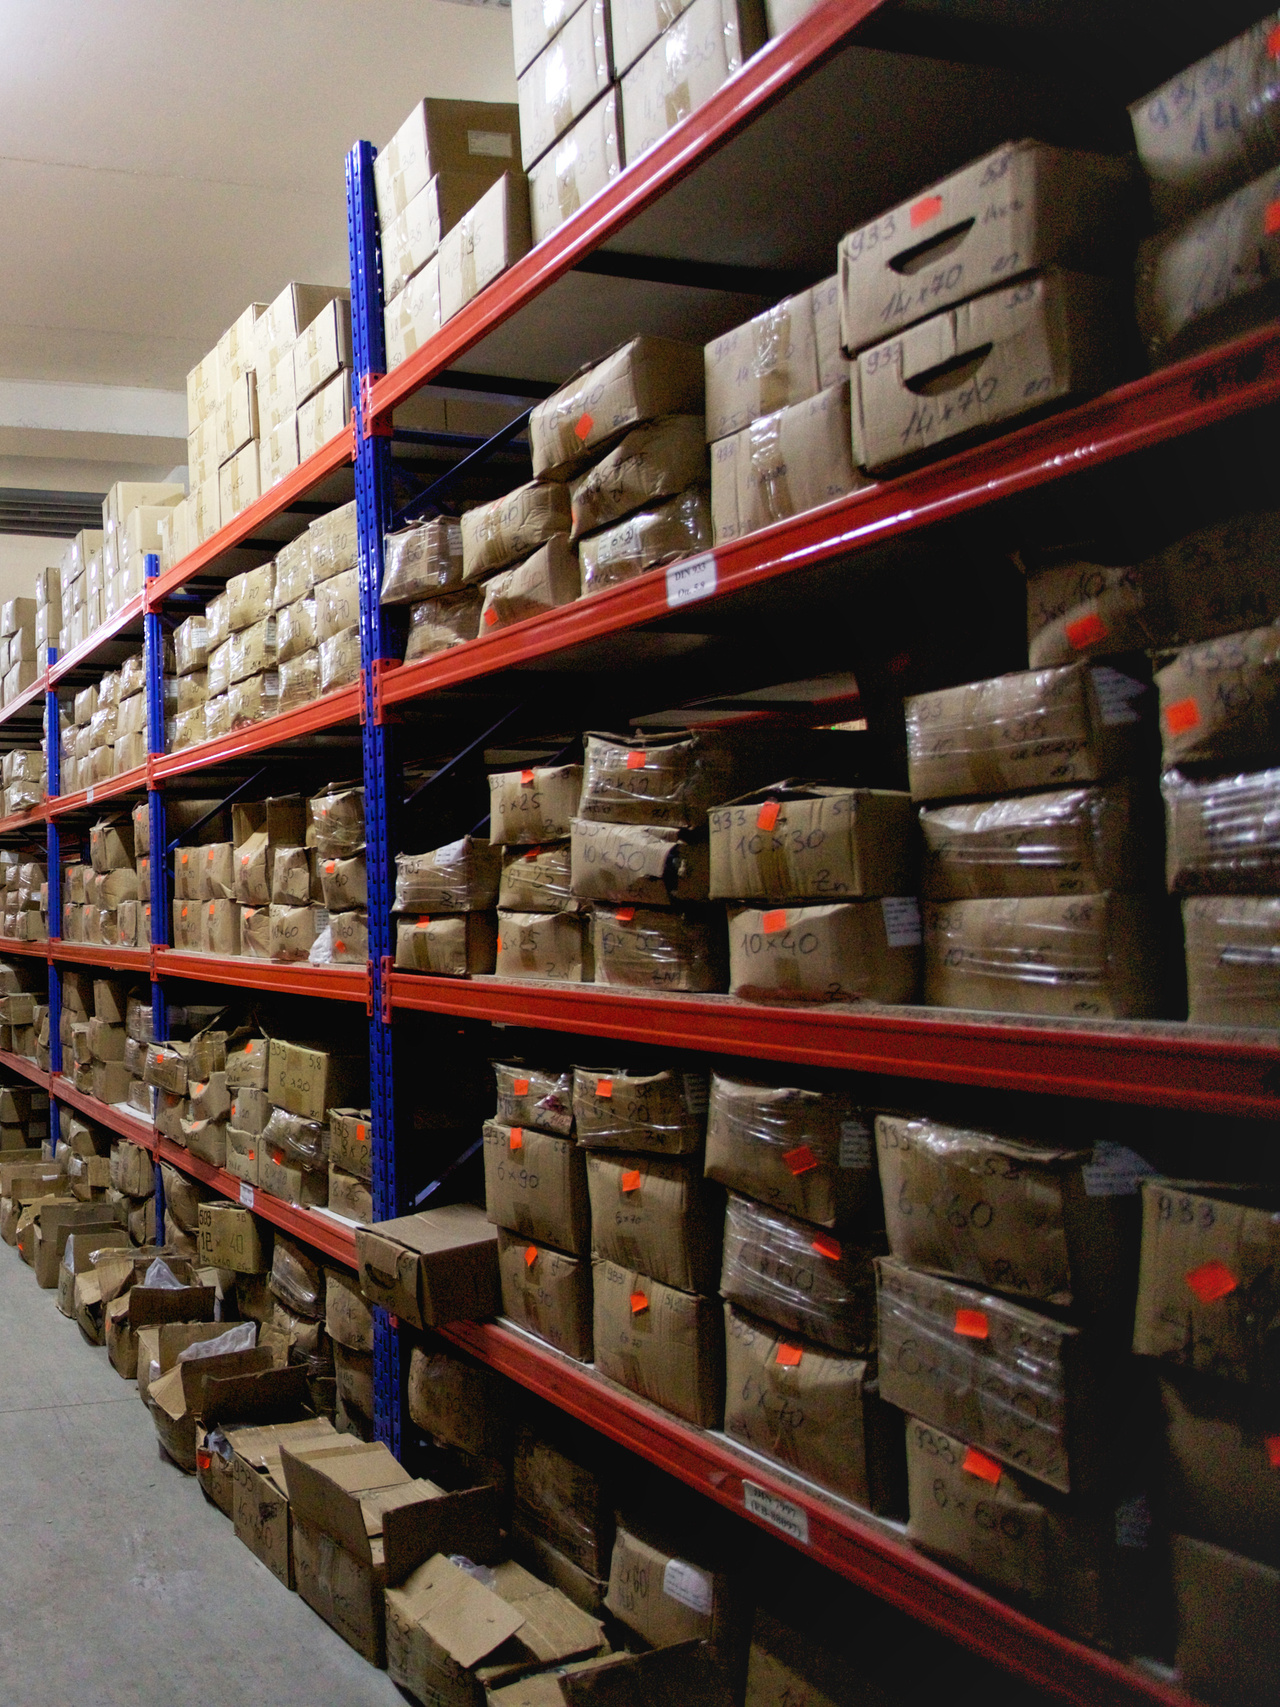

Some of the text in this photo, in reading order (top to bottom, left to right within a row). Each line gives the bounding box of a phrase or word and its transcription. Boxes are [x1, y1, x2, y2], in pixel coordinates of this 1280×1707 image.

[849, 213, 897, 262] 933
[674, 567, 690, 581] DIN
[710, 812, 748, 834] 933
[739, 931, 821, 957] 10x40
